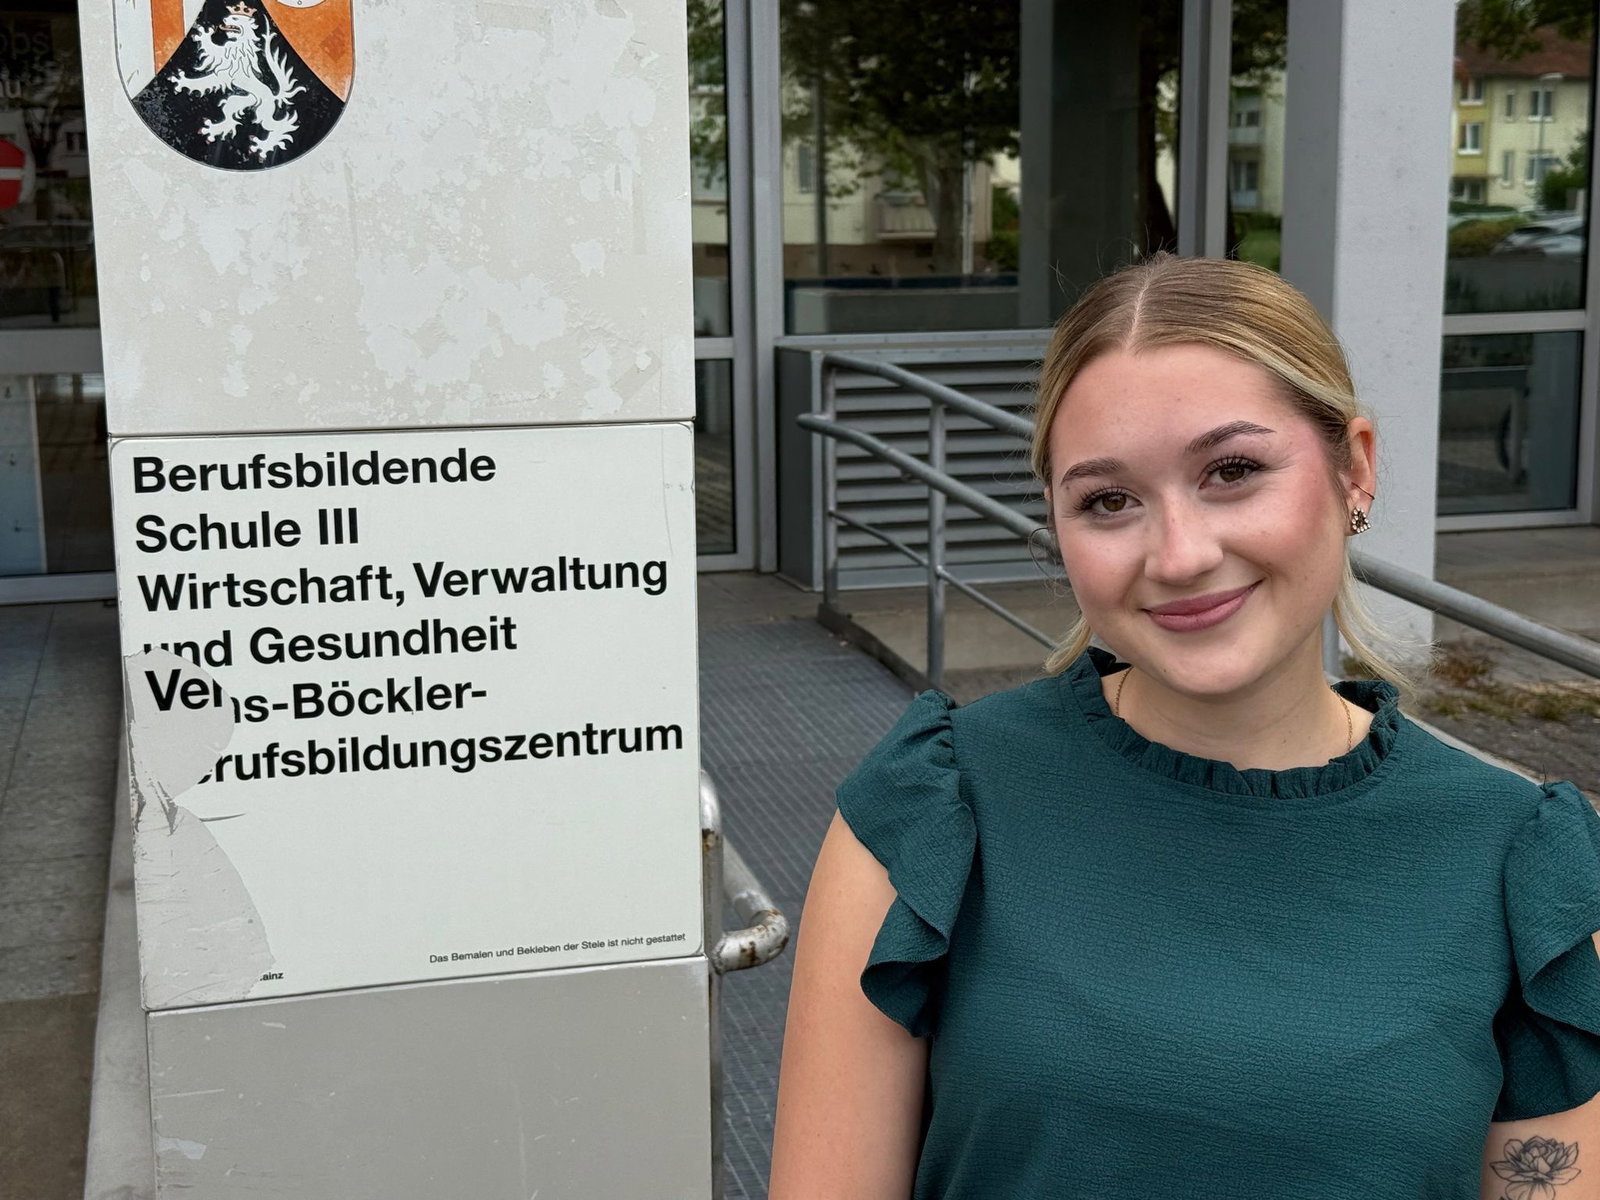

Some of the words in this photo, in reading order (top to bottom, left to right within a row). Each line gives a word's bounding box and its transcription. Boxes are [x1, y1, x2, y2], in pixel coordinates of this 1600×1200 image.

[133, 448, 496, 494] Berufsbildende
[135, 511, 301, 554] Schule
[318, 507, 359, 545] III
[137, 565, 405, 612] Wirtschaft,
[412, 556, 667, 597] Verwaltung
[143, 630, 233, 668] nd
[249, 615, 517, 665] Gesundheit
[197, 723, 683, 785] rufsbildungszentrum
[429, 954, 449, 963] Das
[451, 950, 493, 961] Bemalen
[496, 948, 514, 957] und
[517, 944, 561, 955] Bekleben
[563, 942, 579, 951] der
[581, 940, 605, 950] Stele
[607, 939, 619, 947] ist
[621, 936, 644, 946] nicht
[646, 933, 686, 945] gestattet
[259, 971, 284, 981] ainz
